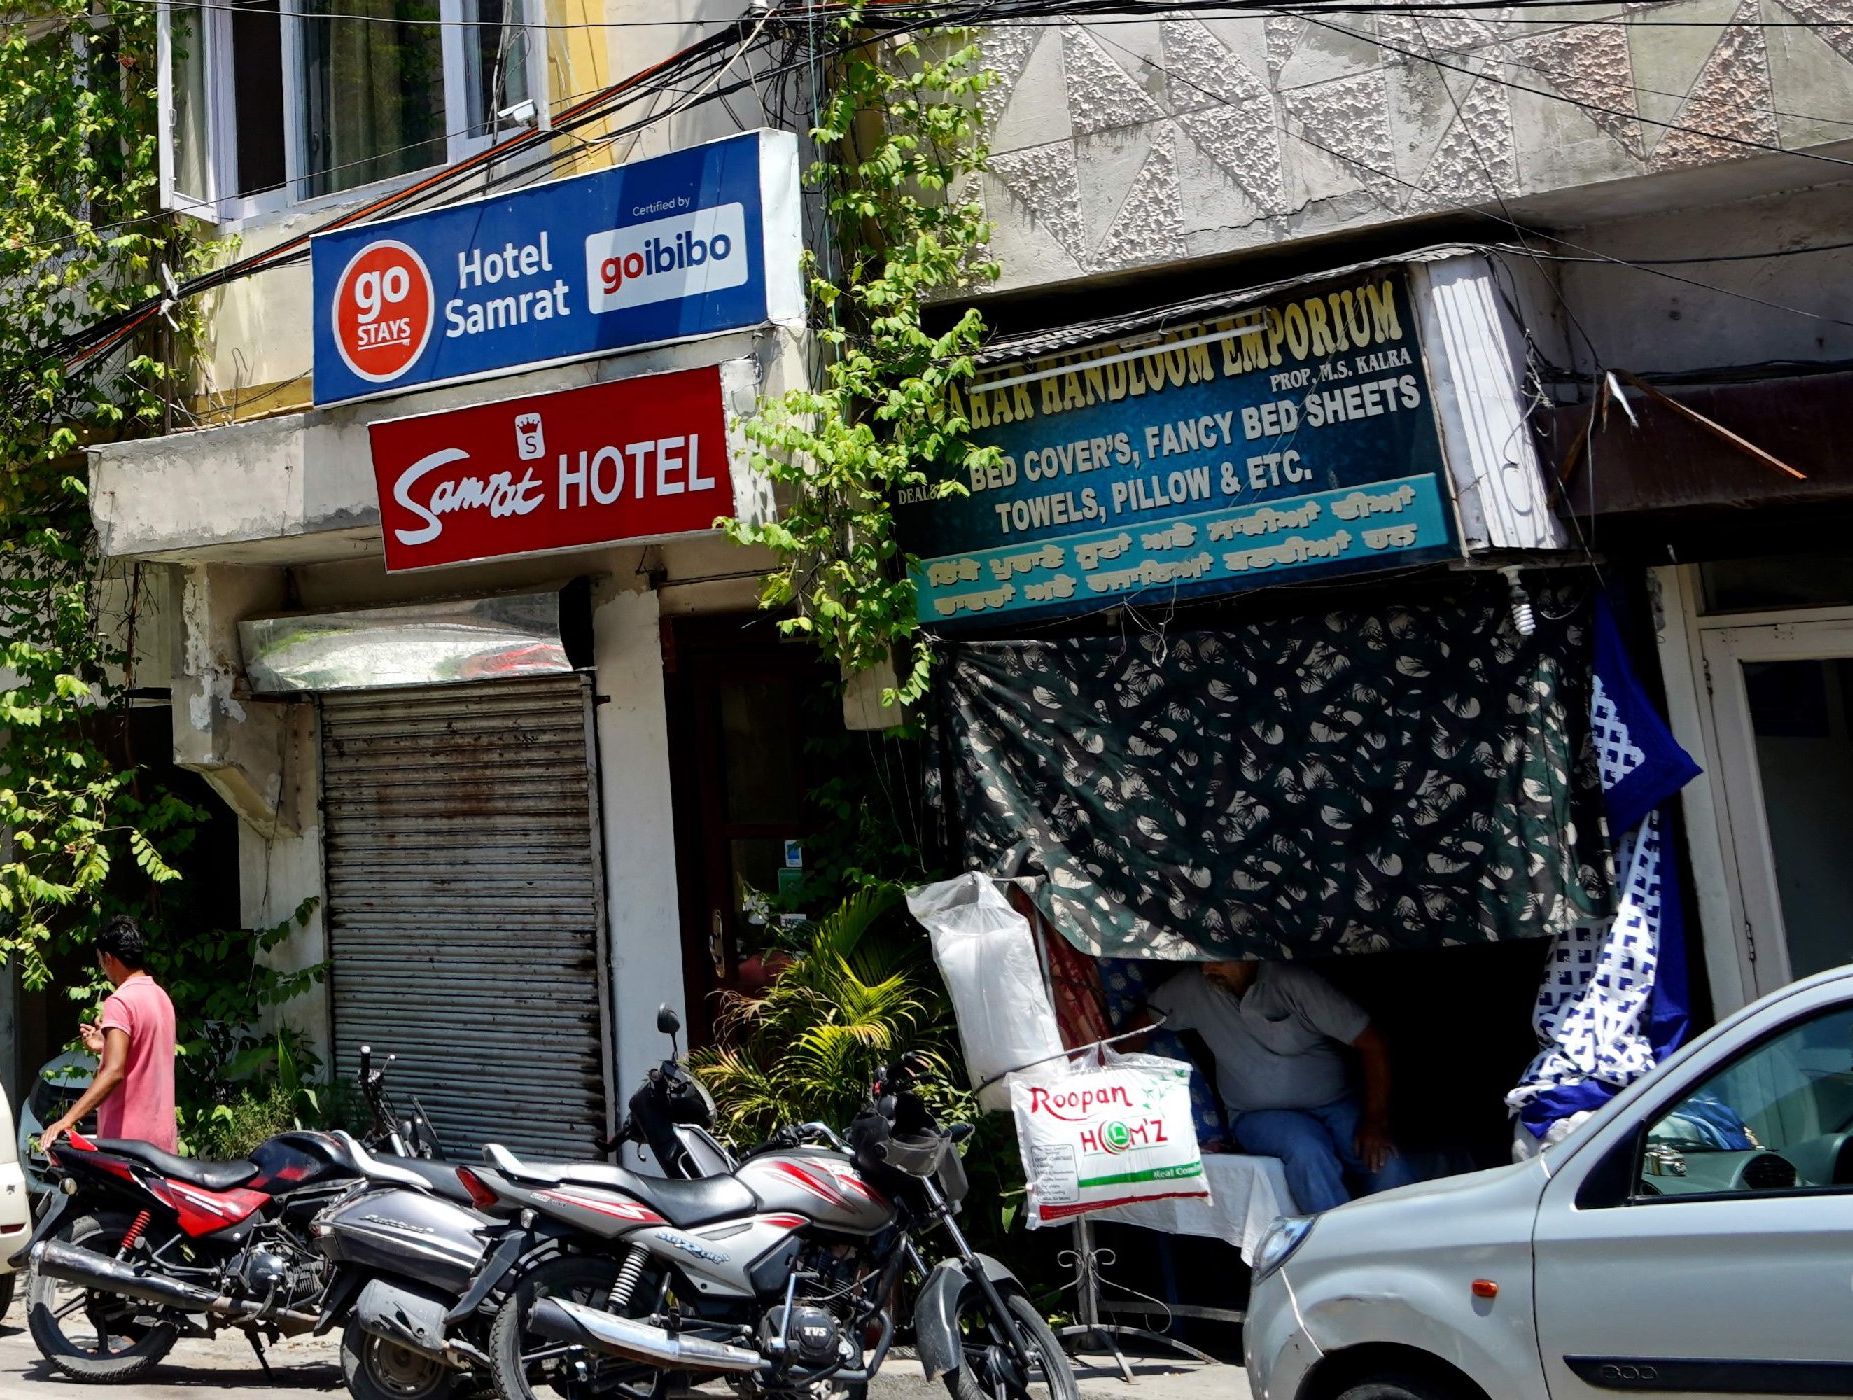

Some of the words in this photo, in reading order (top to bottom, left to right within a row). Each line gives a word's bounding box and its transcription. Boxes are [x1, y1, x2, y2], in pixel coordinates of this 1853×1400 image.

[632, 197, 675, 217] Certified
[677, 196, 690, 208] by
[458, 231, 552, 290] Hotel
[600, 230, 731, 294] goibibo
[355, 267, 410, 322] go
[446, 279, 570, 338] Samrat
[357, 317, 411, 346] STAYS
[1037, 322, 1214, 415] HANDLOOM
[1216, 280, 1403, 377] EMPORIUM
[1319, 359, 1354, 382] M.S.
[1355, 346, 1414, 376] KALRA
[969, 451, 1018, 493] BED
[1024, 432, 1141, 482] COVER'S,
[1144, 410, 1234, 459] FANCY
[1241, 399, 1300, 441] BED
[1305, 374, 1422, 428] SHEETS
[394, 447, 545, 545] Samrat
[558, 433, 715, 509] HOTEL
[995, 486, 1107, 534] TOWELS,
[1111, 465, 1212, 515] PILLOW
[1221, 461, 1242, 496] &
[1246, 449, 1314, 491] ETC.
[1029, 1086, 1134, 1122] Roopan
[804, 1326, 827, 1337] TVS
